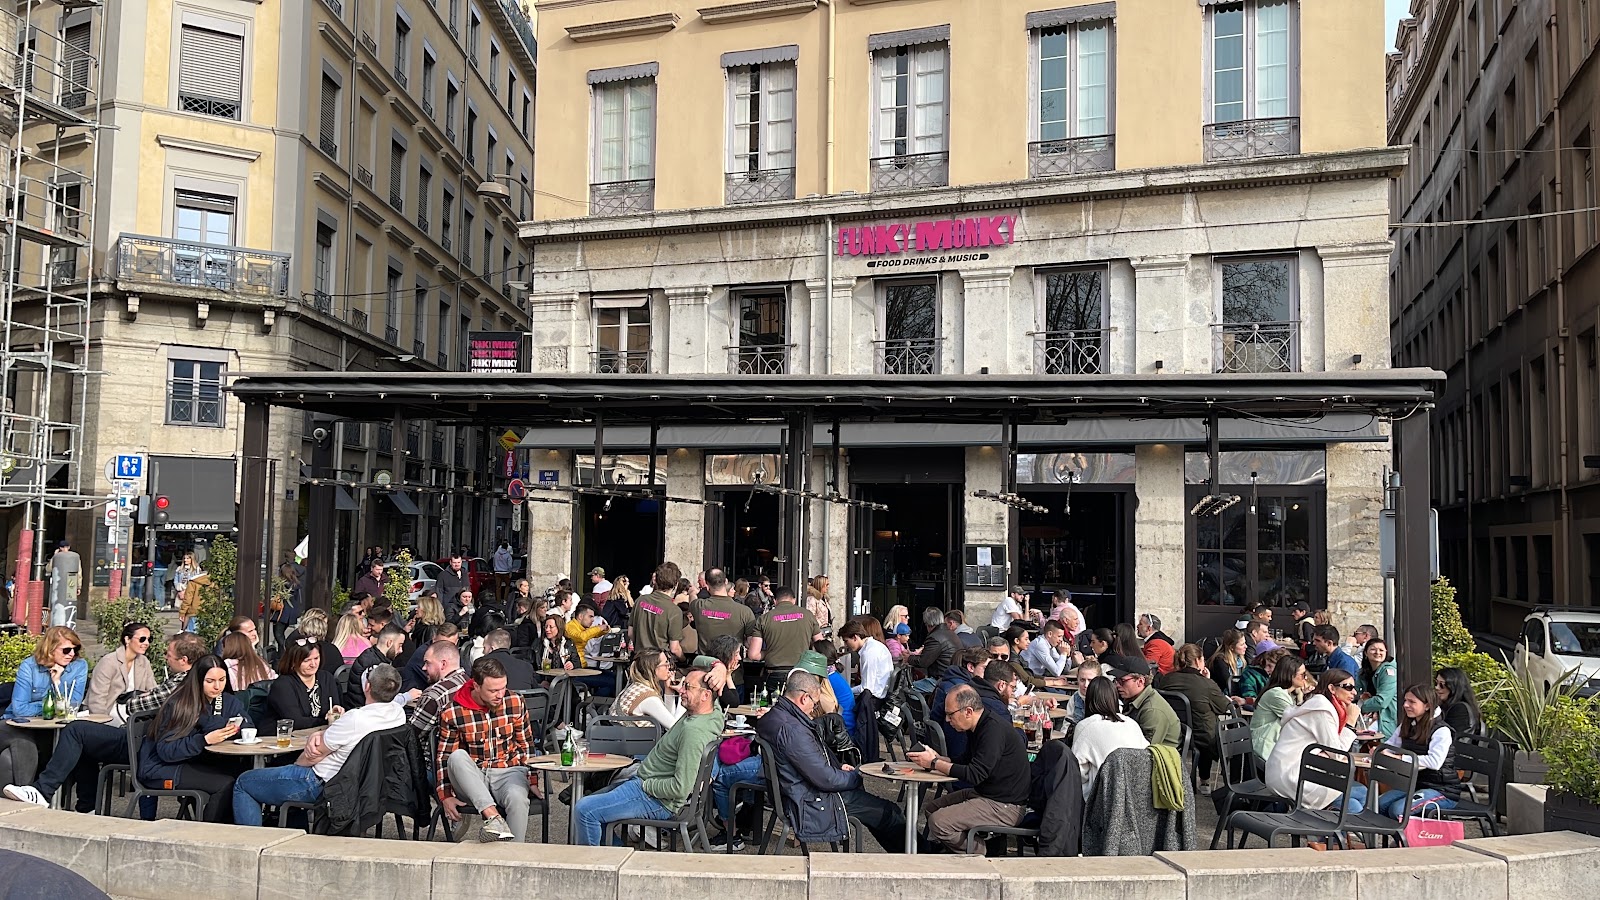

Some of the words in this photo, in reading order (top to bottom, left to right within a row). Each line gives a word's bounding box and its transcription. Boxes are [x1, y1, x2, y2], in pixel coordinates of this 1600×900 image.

[838, 223, 912, 257] FUNKY
[915, 214, 1018, 251] MONKY
[876, 259, 901, 268] FOOD
[903, 256, 938, 266] DRINKS
[947, 253, 979, 263] MUSIC
[1418, 830, 1443, 839] Etam
